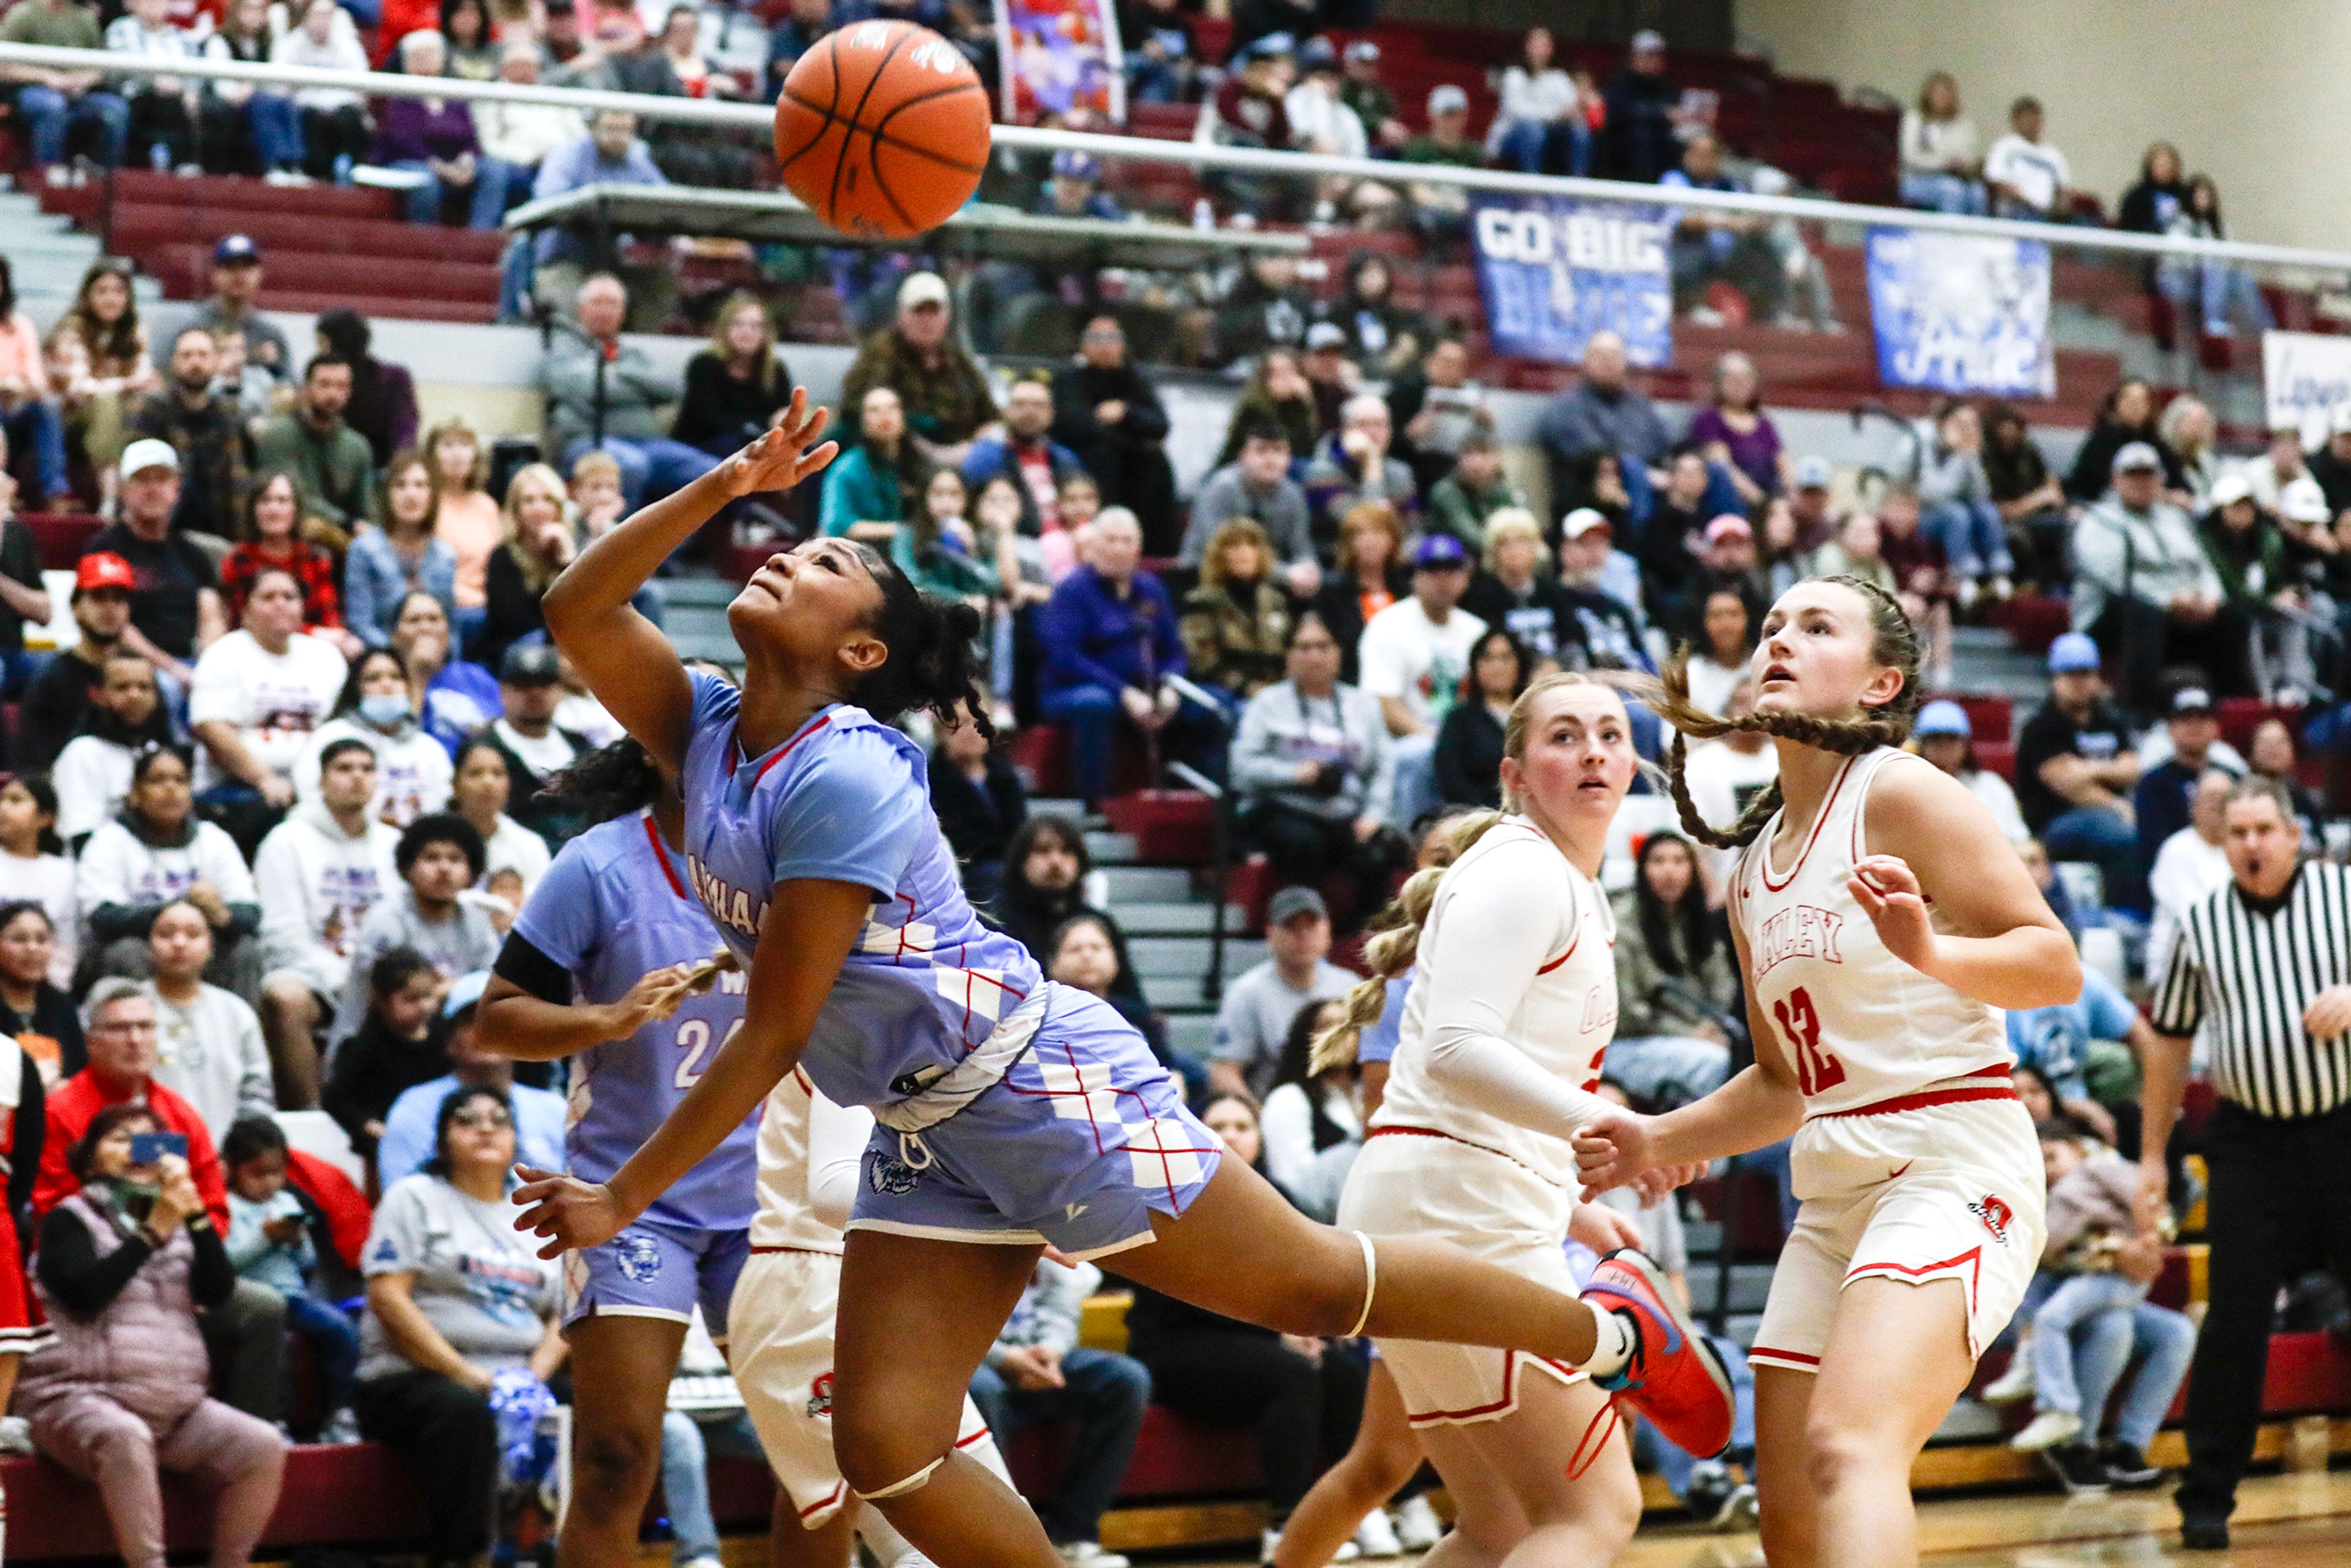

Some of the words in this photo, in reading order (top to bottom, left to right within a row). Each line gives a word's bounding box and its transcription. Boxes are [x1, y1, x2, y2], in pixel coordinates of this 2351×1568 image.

[1477, 208, 1553, 265] GO
[1567, 216, 1668, 275] BIG
[1774, 986, 1847, 1097] 12
